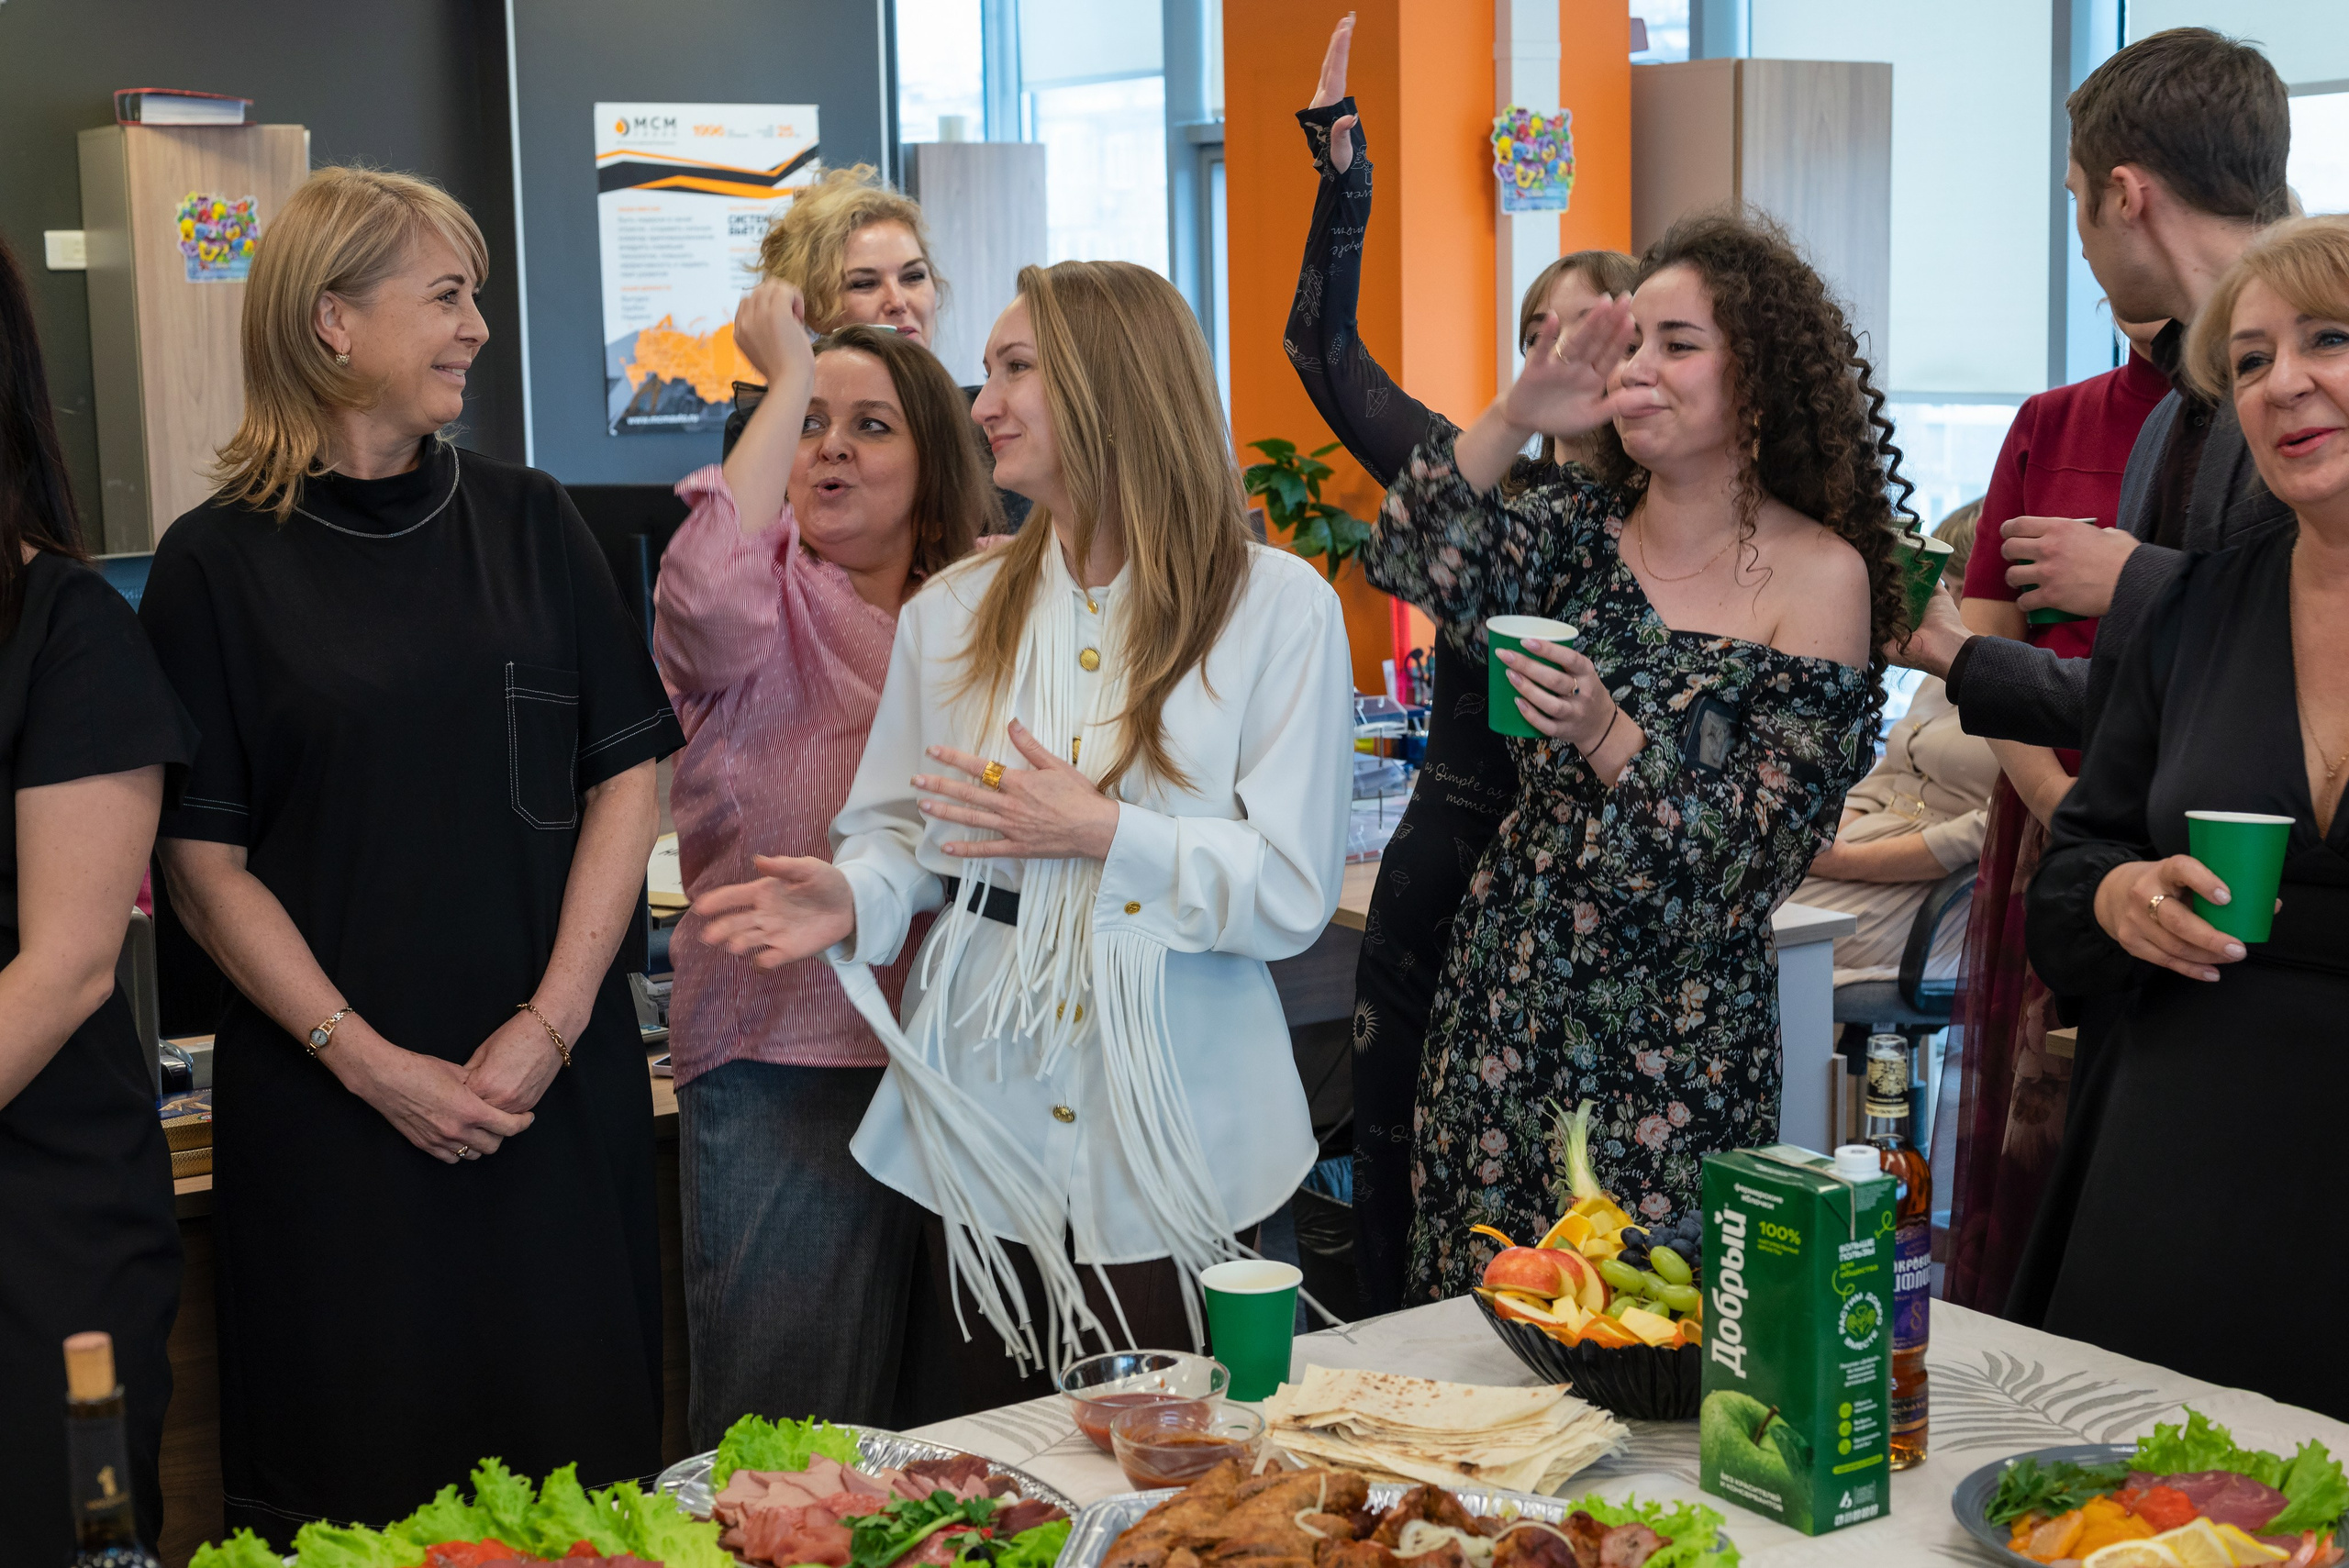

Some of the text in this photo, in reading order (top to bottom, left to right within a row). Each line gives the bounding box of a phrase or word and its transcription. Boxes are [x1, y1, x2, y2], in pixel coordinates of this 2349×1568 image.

[1424, 762, 1434, 774] as
[1435, 762, 1483, 792] Simple
[1486, 787, 1507, 800] as
[1369, 1124, 1386, 1137] as
[1758, 1220, 1801, 1245] 100%
[1838, 1238, 1876, 1253] БОЛЬШЕ
[1838, 1247, 1876, 1262] ПОЛЬЗЫ
[1711, 1208, 1749, 1379] Добрый
[1838, 1291, 1883, 1335] РАСТИМ ДОБРО
[1843, 1329, 1879, 1351] ВМЕСТЕ
